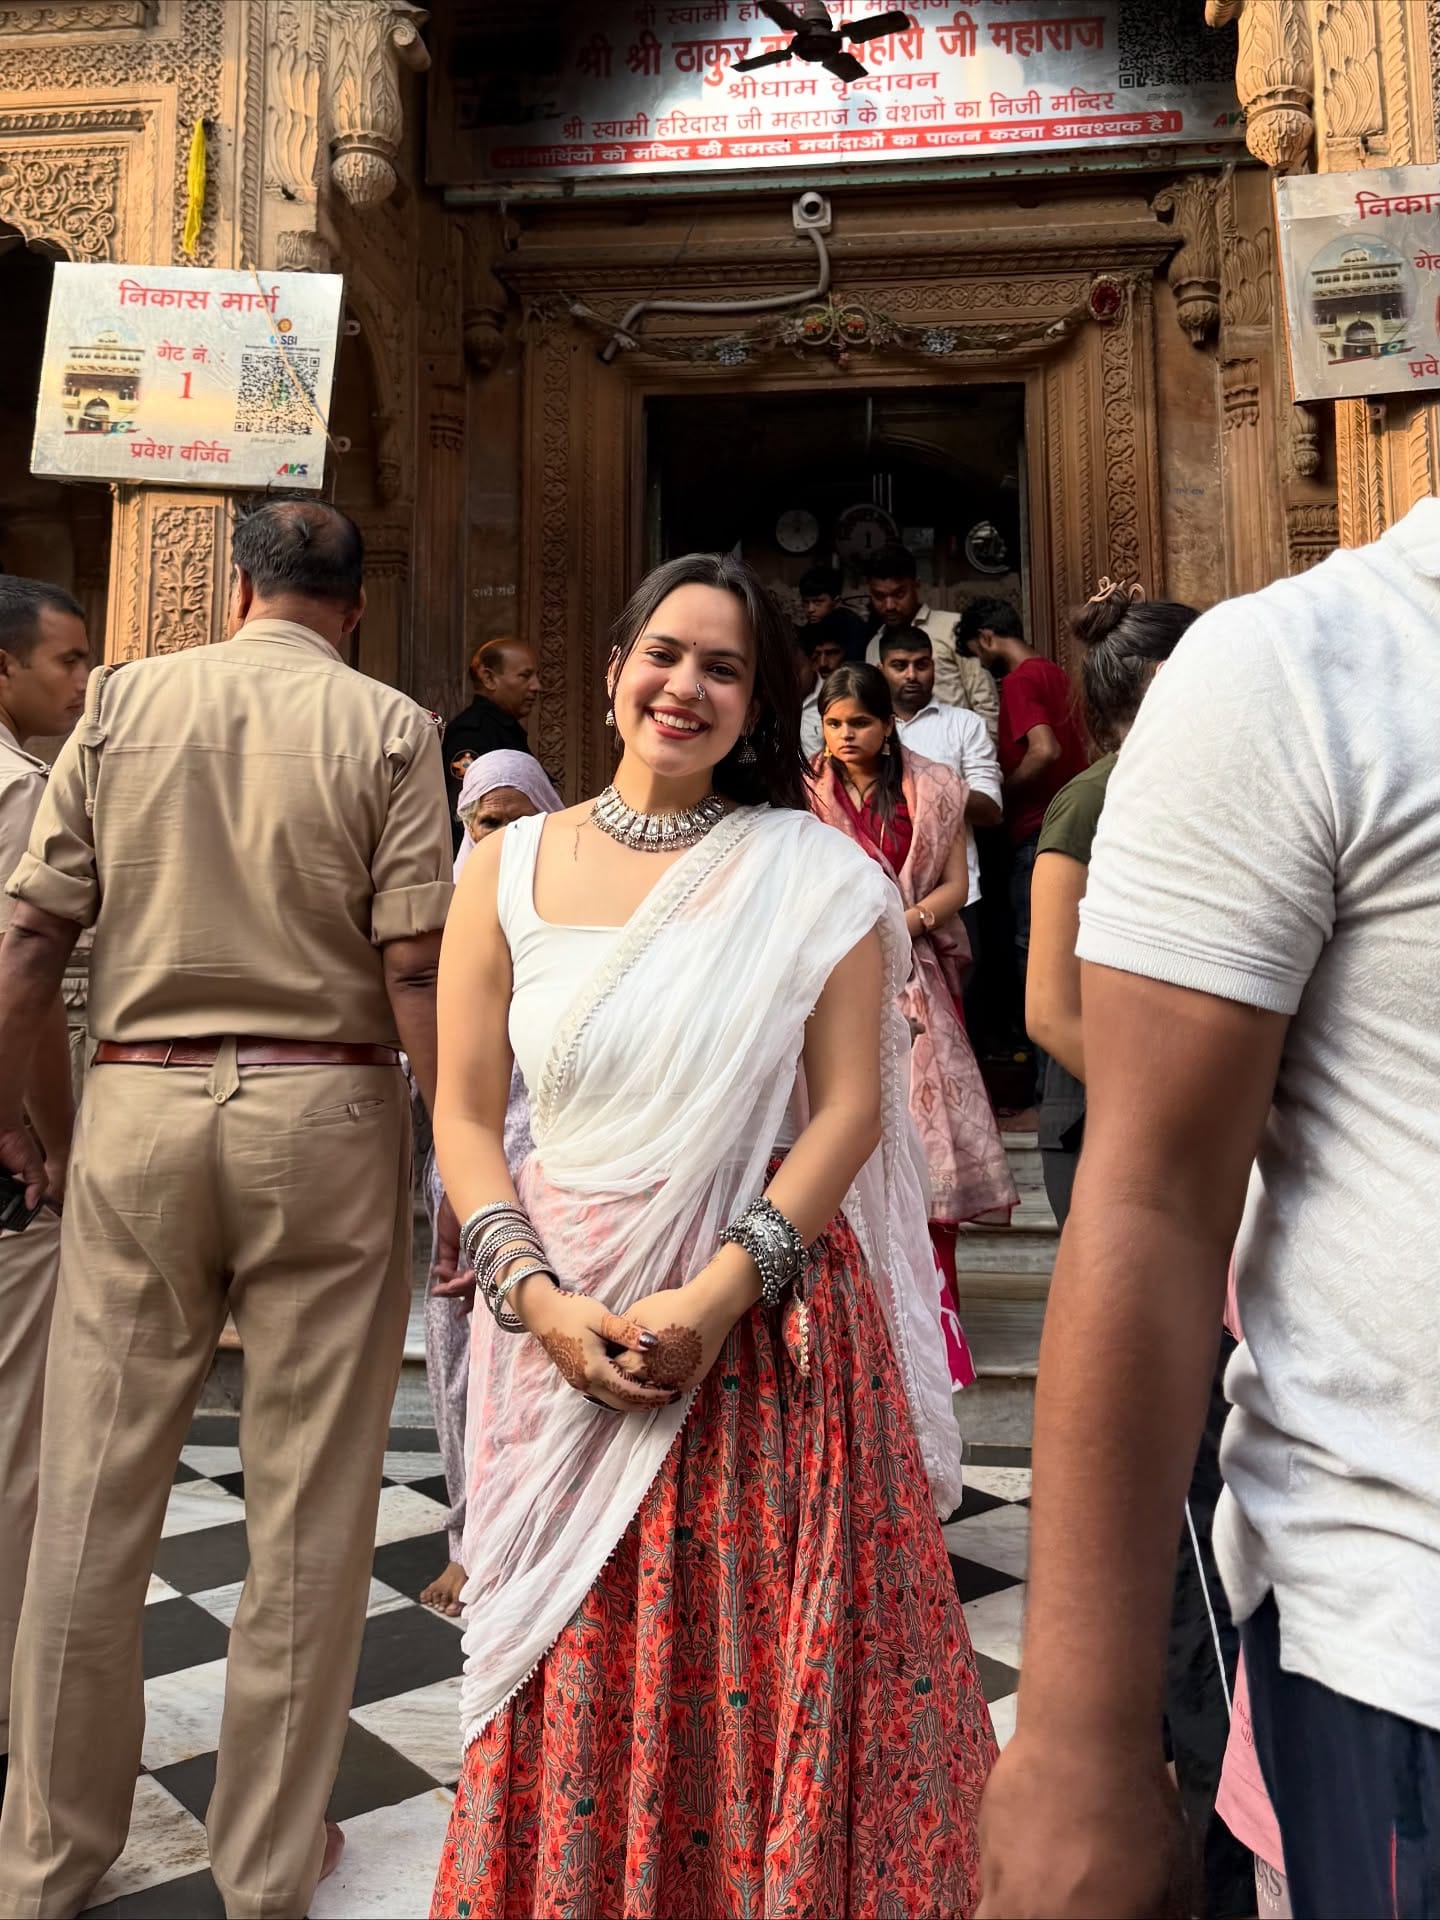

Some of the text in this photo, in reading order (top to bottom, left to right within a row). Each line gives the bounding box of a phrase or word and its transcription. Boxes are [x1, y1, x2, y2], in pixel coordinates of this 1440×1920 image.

[626, 30, 661, 76] श्री
[671, 37, 752, 86] ठाकुर
[936, 11, 978, 57] जी
[987, 17, 1105, 57] महाराज
[727, 72, 940, 100] श्रीधाम वृन्दावन
[561, 114, 584, 140] श्री
[592, 112, 649, 138] स्वामी
[656, 110, 728, 136] हरिदास
[736, 106, 762, 130] जी
[772, 109, 849, 131] महाराज
[857, 99, 878, 124] के
[885, 96, 945, 123] वंशजों
[955, 100, 981, 119] का
[989, 89, 1041, 118] निजी
[1050, 87, 1115, 113] मन्दिर
[601, 144, 627, 162] को
[633, 143, 690, 160] मन्दिर
[696, 140, 723, 156] की
[798, 131, 885, 152] मर्यादाओं
[892, 133, 918, 147] का
[925, 129, 982, 147] पालन
[989, 126, 1045, 141] करना
[1052, 119, 1142, 138] आवश्यक
[1355, 190, 1440, 220] निका
[118, 278, 280, 314] निकास मार्ग
[157, 339, 186, 362] गेट
[280, 335, 297, 346] SBI
[178, 371, 194, 400] 1
[130, 437, 232, 464] प्रवेश वर्जित
[276, 463, 309, 476] AVS
